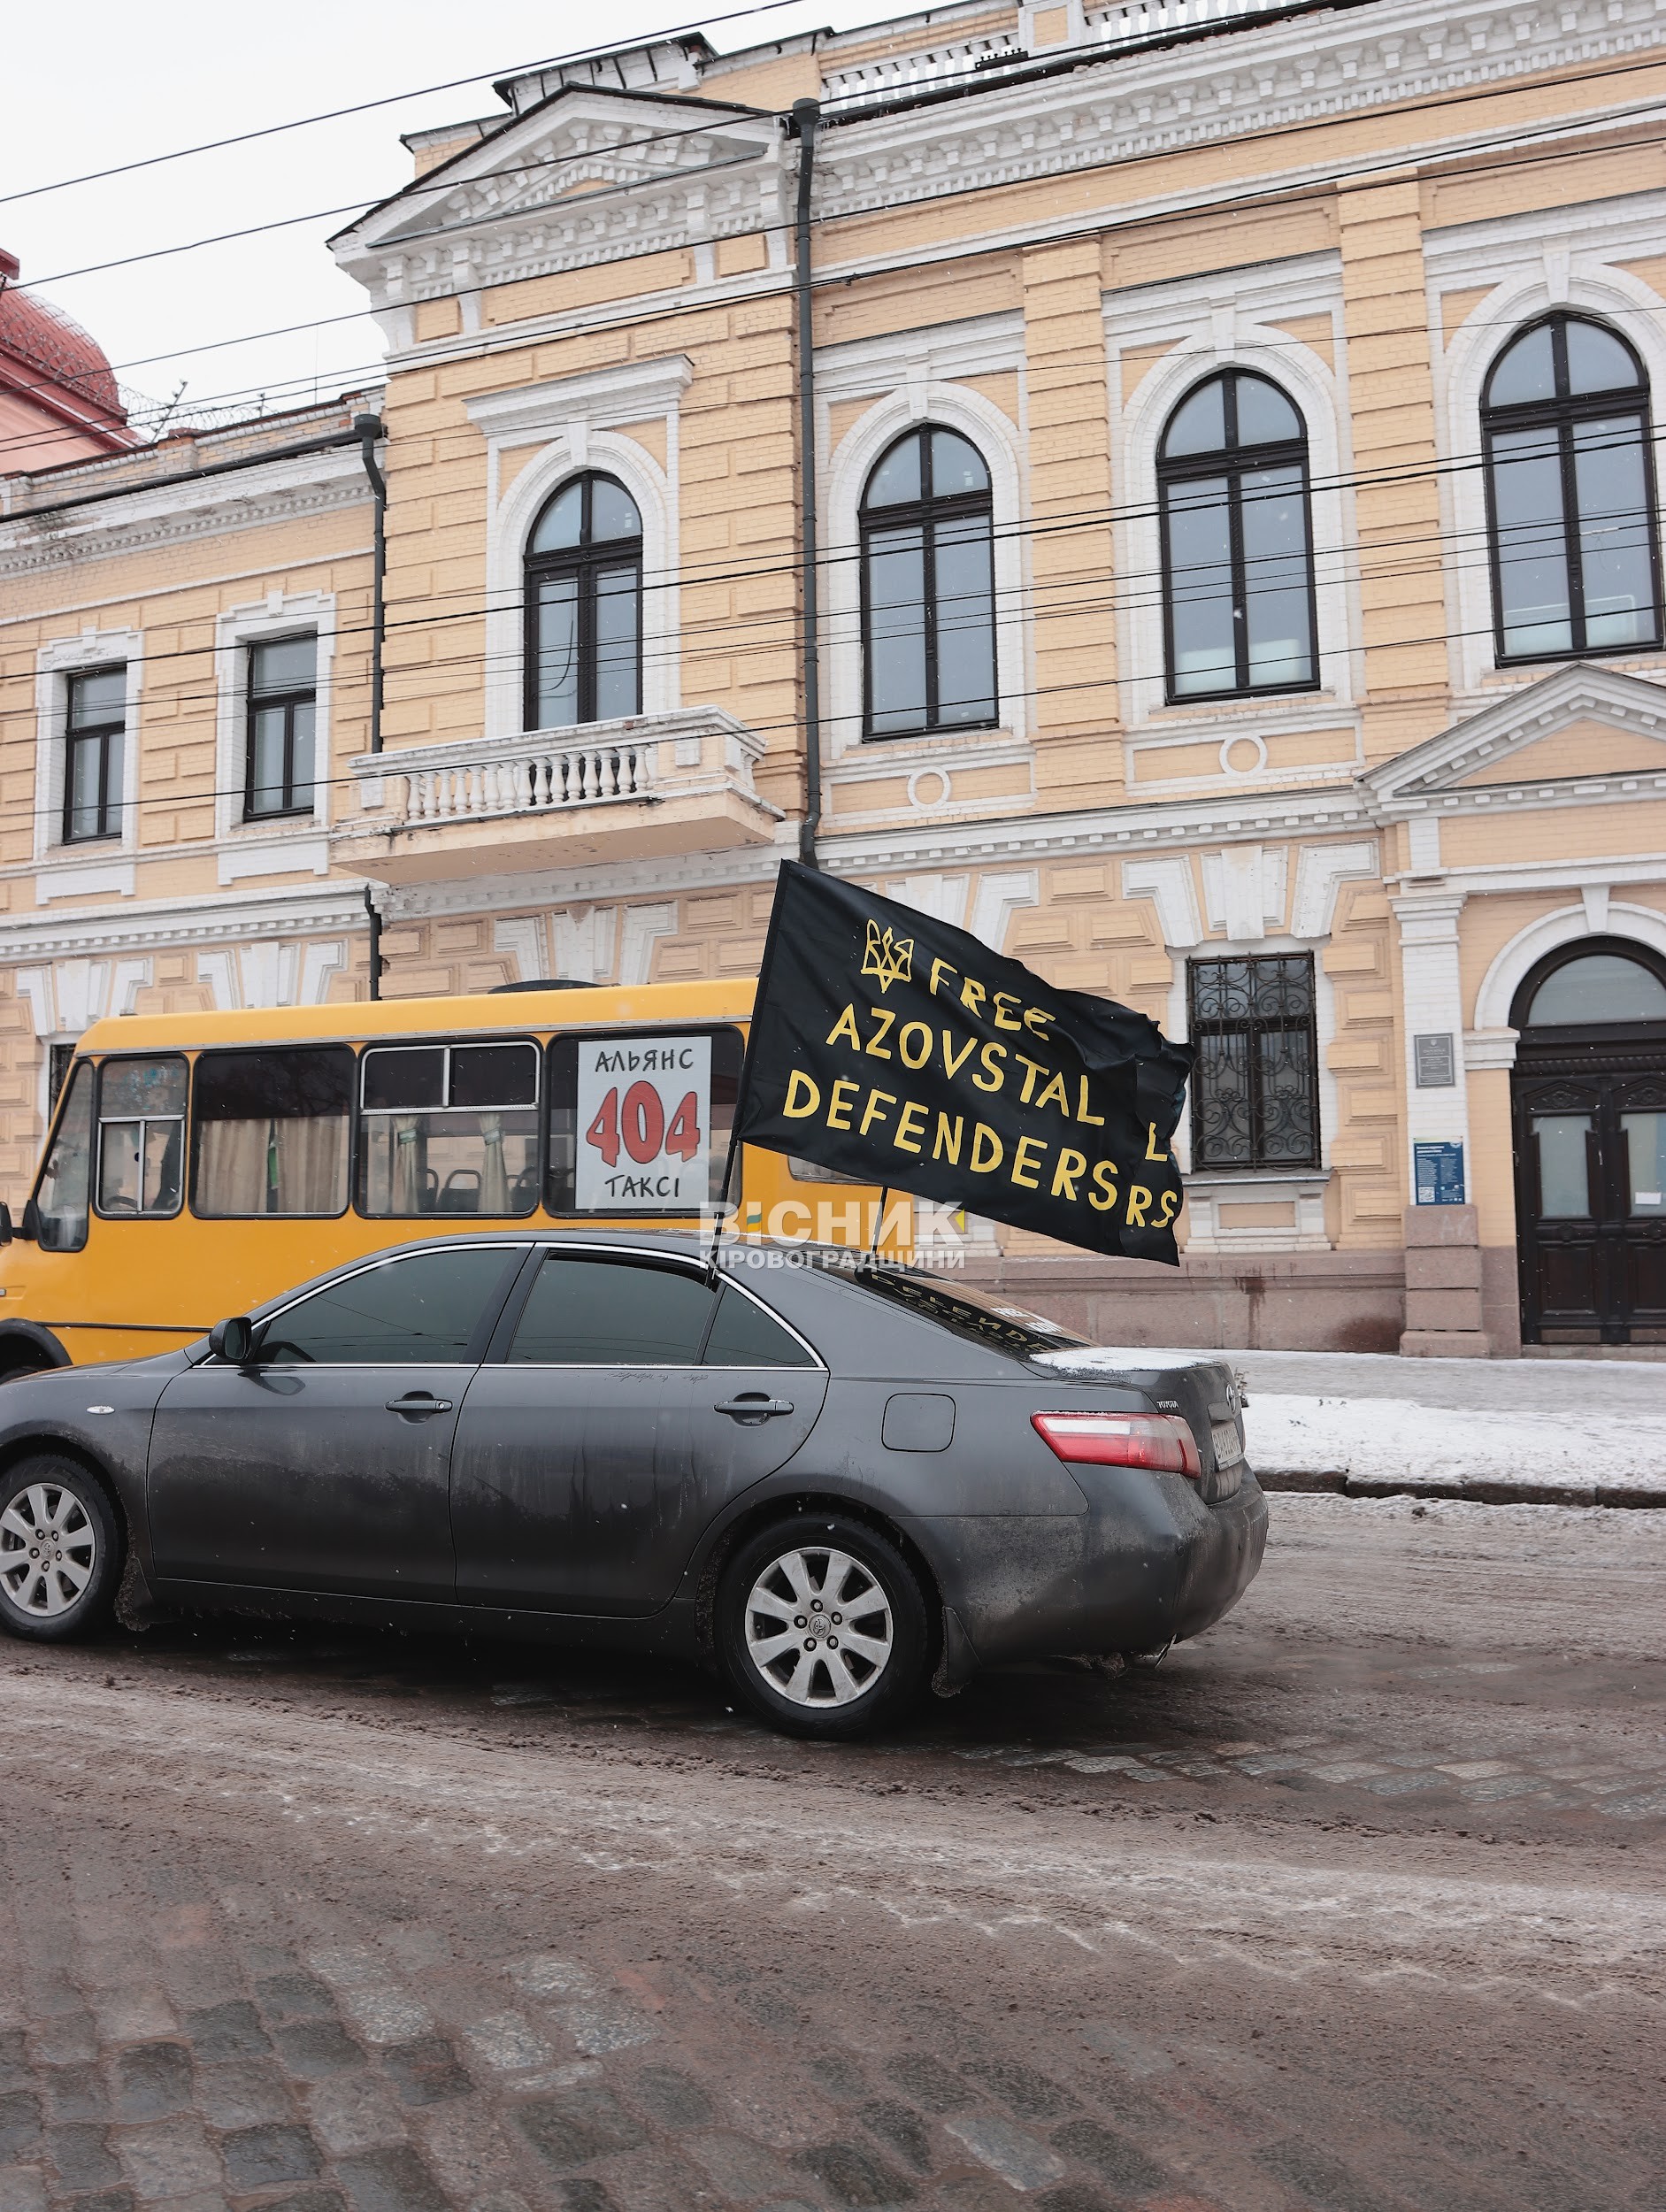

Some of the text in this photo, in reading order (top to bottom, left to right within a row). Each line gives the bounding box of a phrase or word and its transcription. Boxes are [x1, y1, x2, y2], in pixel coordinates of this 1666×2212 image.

[929, 957, 1056, 1041] FREE
[595, 1048, 695, 1072] АЛЬЯНС
[825, 1002, 1105, 1126] AZOVSTAL
[586, 1080, 701, 1168] 404
[782, 1069, 1119, 1211] DEFENDERS
[604, 1174, 679, 1198] ТАКСІ
